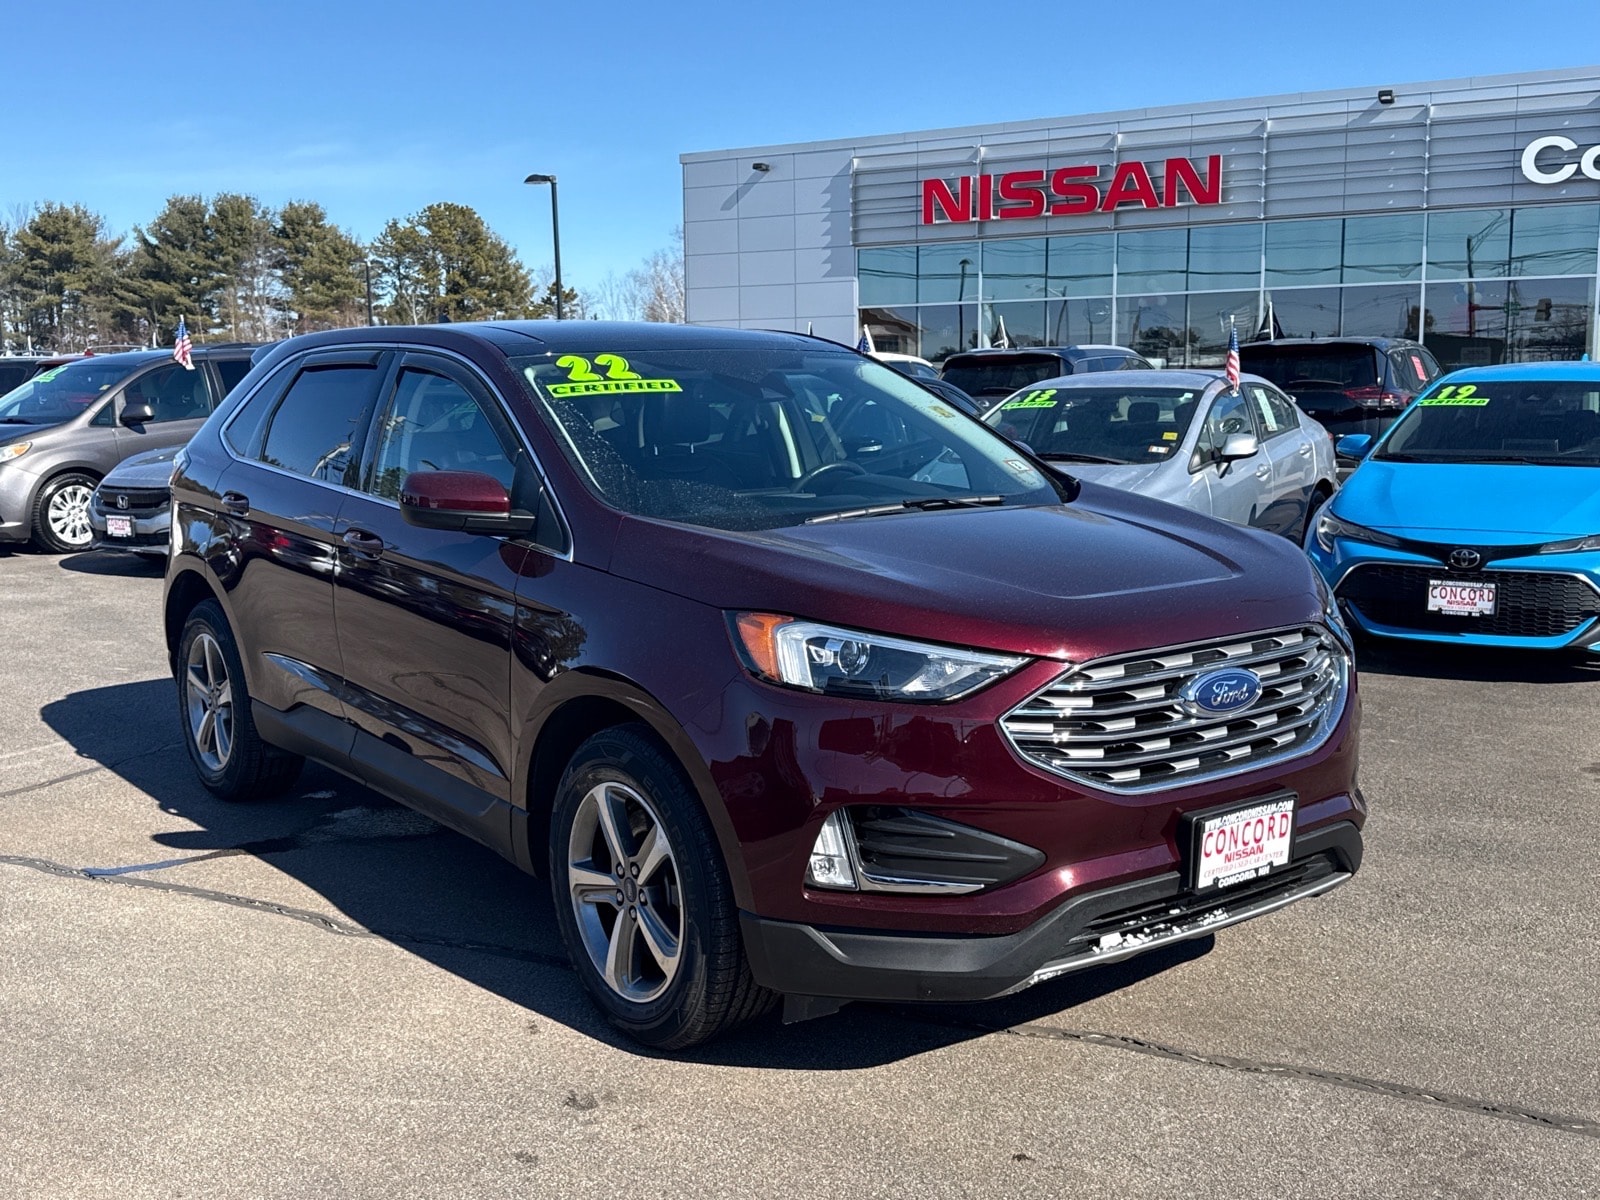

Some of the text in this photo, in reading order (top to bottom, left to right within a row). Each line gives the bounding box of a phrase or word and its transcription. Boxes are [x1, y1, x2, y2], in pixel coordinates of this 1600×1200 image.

[922, 154, 1223, 225] NISSAN
[555, 353, 642, 381] 22
[551, 381, 674, 395] CERTIFIED
[1023, 389, 1058, 402] 13
[1437, 384, 1477, 400] 19
[1431, 587, 1494, 601] CONCORD
[1211, 680, 1248, 706] Ford
[1204, 814, 1288, 857] CONCORD
[1224, 844, 1264, 863] NISSAN
[1204, 863, 1234, 879] CERTIFIED
